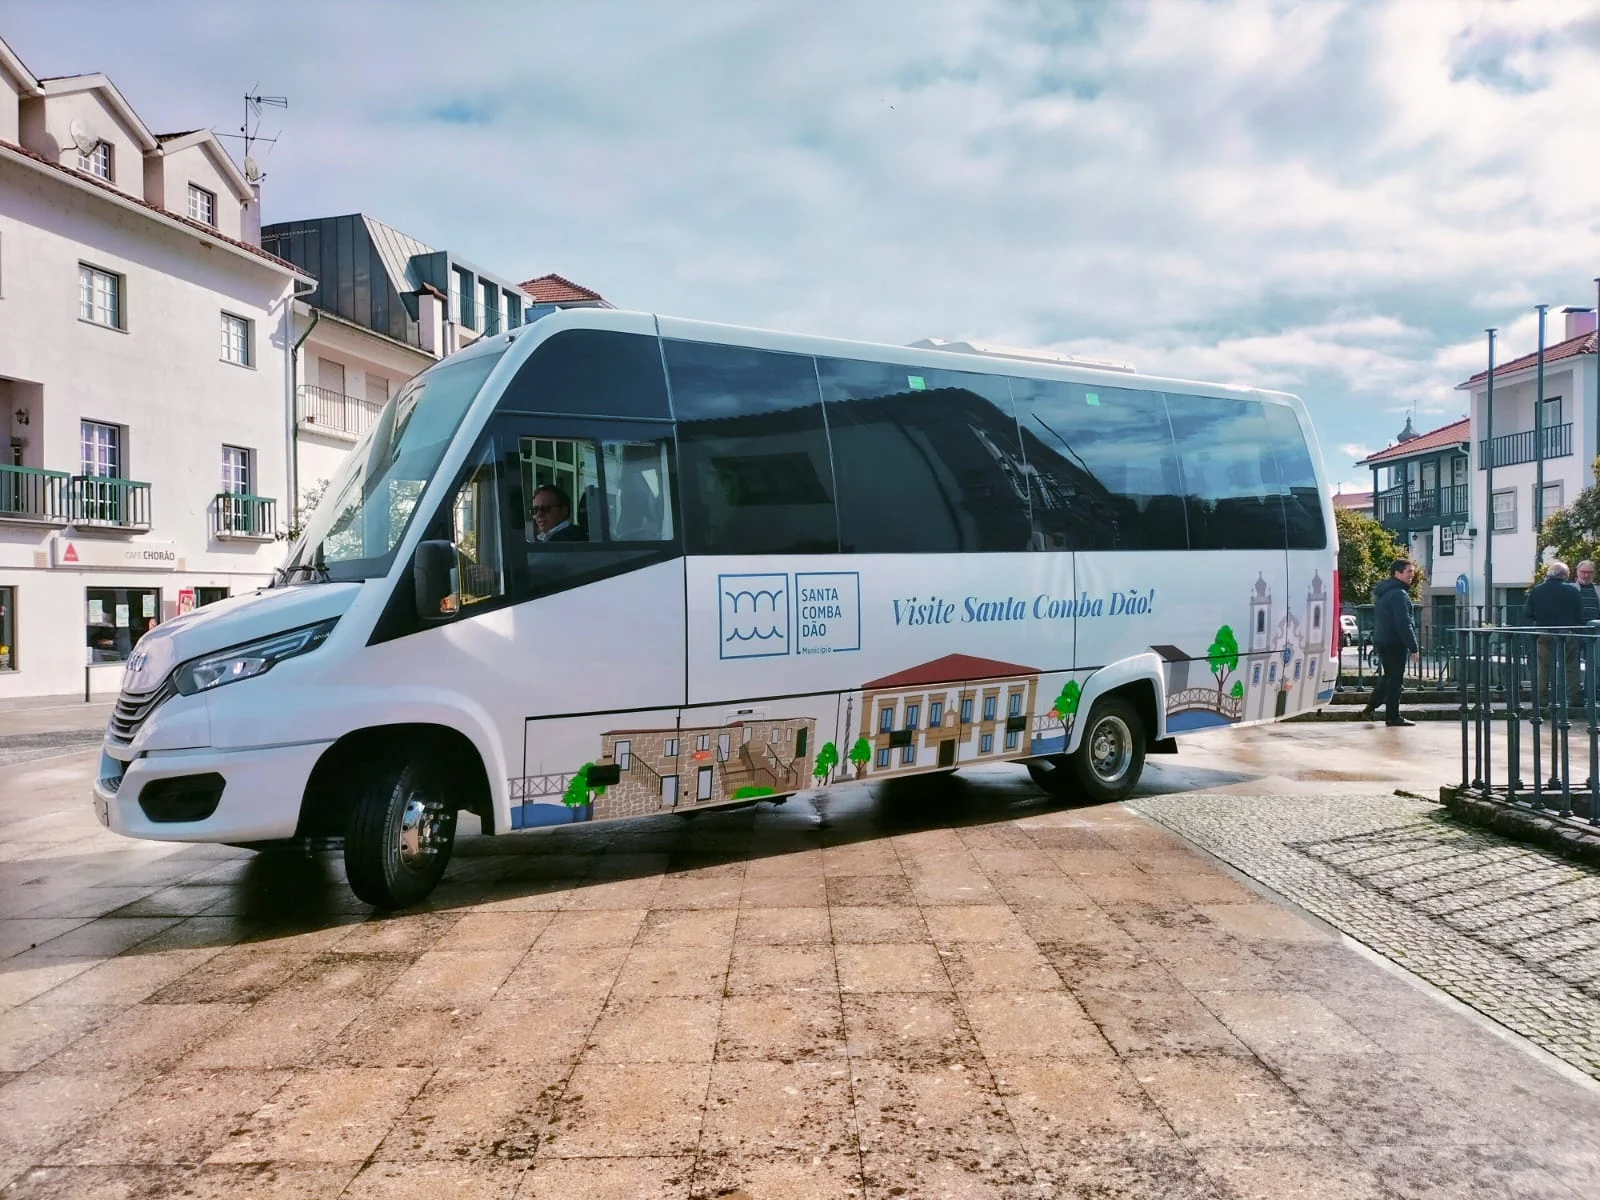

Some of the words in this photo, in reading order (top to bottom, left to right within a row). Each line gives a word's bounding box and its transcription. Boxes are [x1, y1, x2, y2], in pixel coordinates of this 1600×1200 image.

[801, 588, 839, 602] SANTA
[802, 605, 842, 619] COMBA
[892, 596, 955, 626] Visite
[961, 595, 1026, 623] Santa
[1033, 591, 1103, 620] Comba
[1108, 588, 1155, 616] Dão!
[802, 620, 827, 637] DÃO
